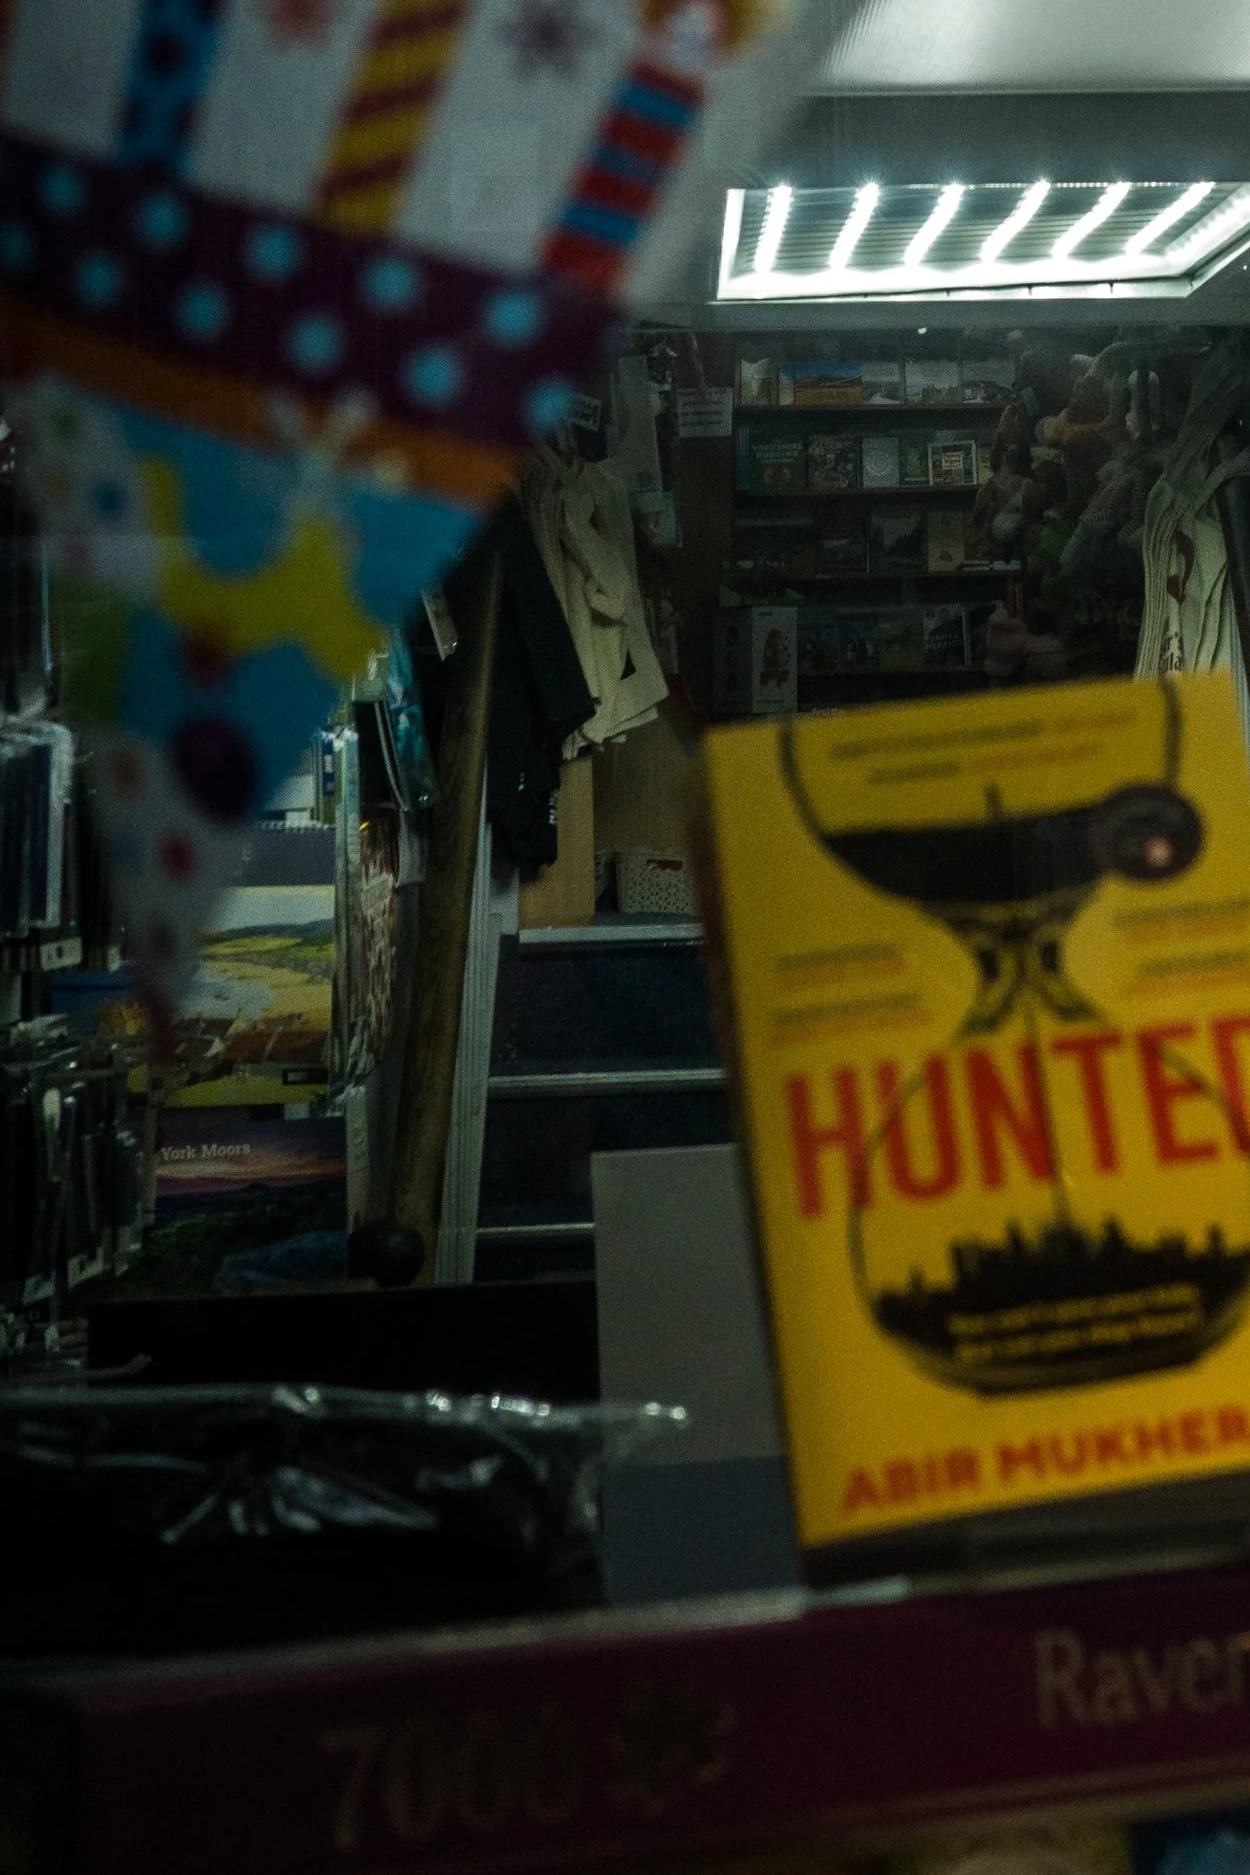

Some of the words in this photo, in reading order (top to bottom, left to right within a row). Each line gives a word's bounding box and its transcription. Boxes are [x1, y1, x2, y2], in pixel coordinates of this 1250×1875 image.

[160, 1145, 197, 1161] York
[201, 1142, 250, 1158] Moors
[842, 1445, 981, 1517] ABIR
